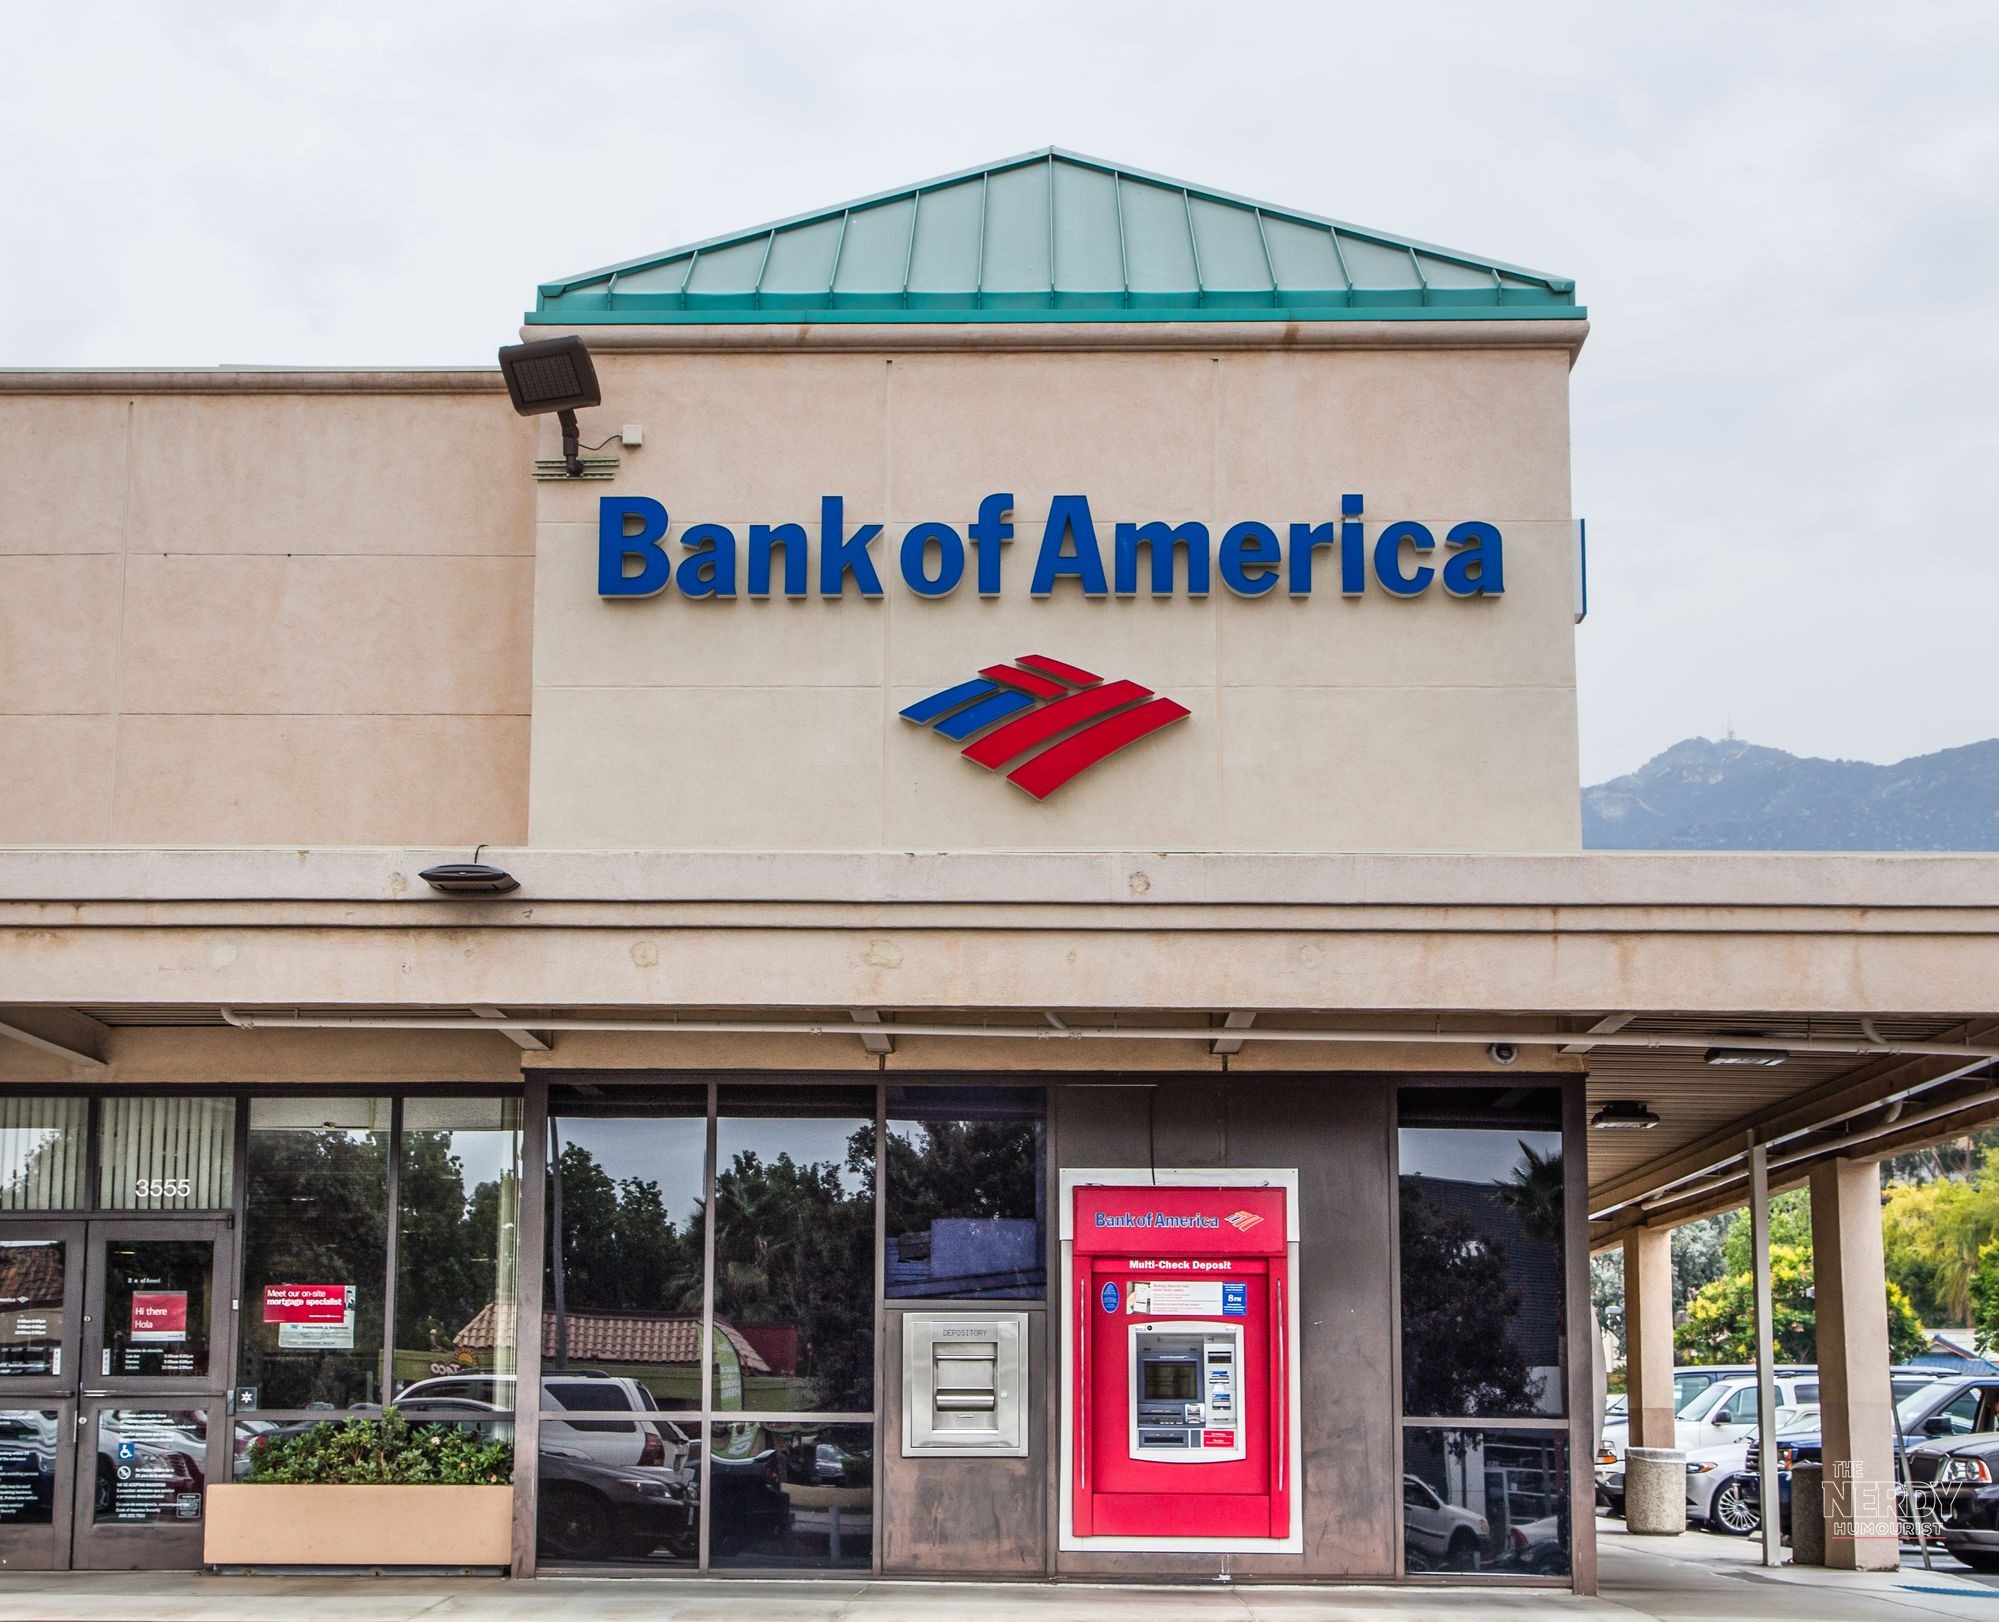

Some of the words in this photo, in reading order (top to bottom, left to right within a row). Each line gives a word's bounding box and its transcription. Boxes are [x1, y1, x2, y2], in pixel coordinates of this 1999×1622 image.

[598, 495, 885, 600] Bank
[899, 493, 1015, 600] of
[1030, 493, 1506, 599] America
[135, 1178, 191, 1197] 3555
[1095, 1211, 1137, 1228] Bank
[1137, 1211, 1154, 1228] of
[1154, 1211, 1220, 1229] America
[1129, 1260, 1190, 1270] Multi-Check
[1192, 1260, 1232, 1271] Deposit
[267, 1289, 287, 1298] Meet
[301, 1289, 326, 1298] on-site
[266, 1298, 304, 1307] mortgage
[305, 1298, 342, 1307] specialist
[135, 1307, 144, 1316] Hi
[146, 1307, 168, 1316] there
[134, 1320, 153, 1329] Hola
[942, 1329, 988, 1337] DEPOSITORY
